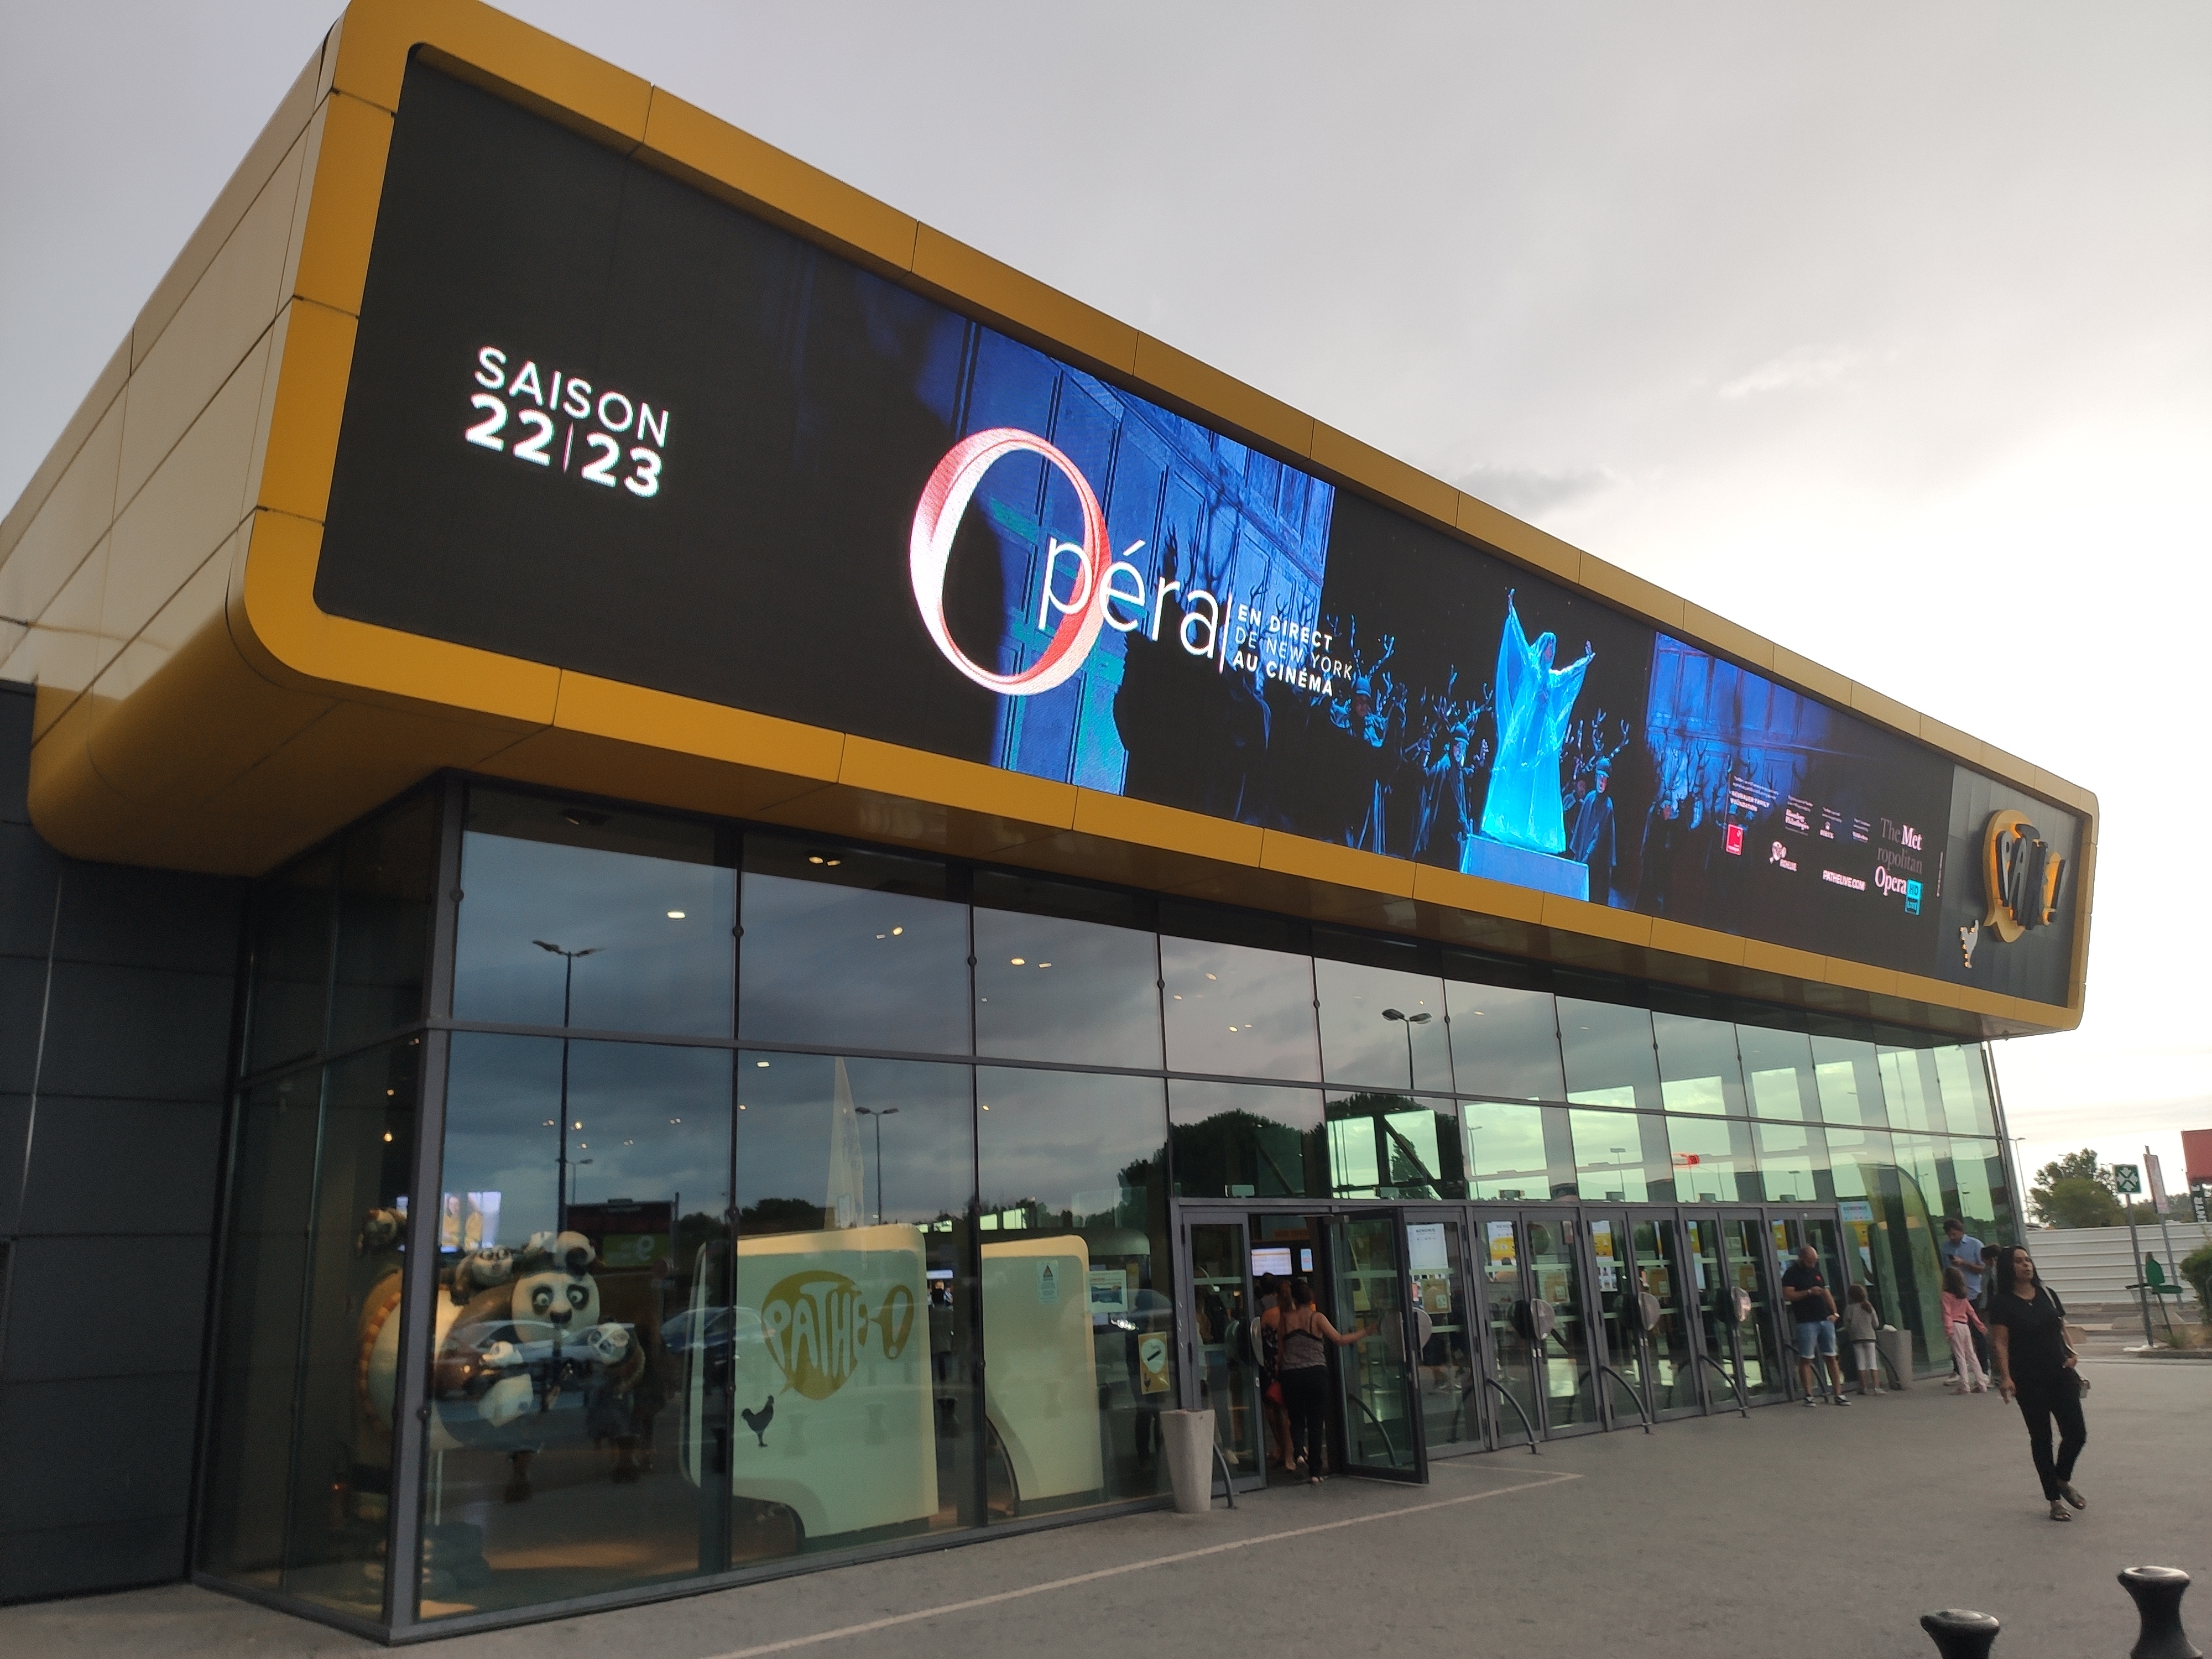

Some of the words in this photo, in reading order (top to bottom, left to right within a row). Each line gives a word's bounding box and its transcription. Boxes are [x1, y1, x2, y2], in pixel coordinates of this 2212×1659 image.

[474, 346, 669, 447] SAISON
[910, 427, 1220, 695] Opéra
[1235, 625, 1258, 649] DE
[1266, 637, 1303, 663] NEW
[1311, 652, 1352, 681] YORK
[1238, 603, 1261, 627] EN
[1269, 615, 1333, 653] DIRECT
[1233, 650, 1258, 672] AU
[1266, 661, 1333, 697] CINÉMA
[1901, 825, 1922, 851] Met
[1875, 865, 1907, 896] Opera
